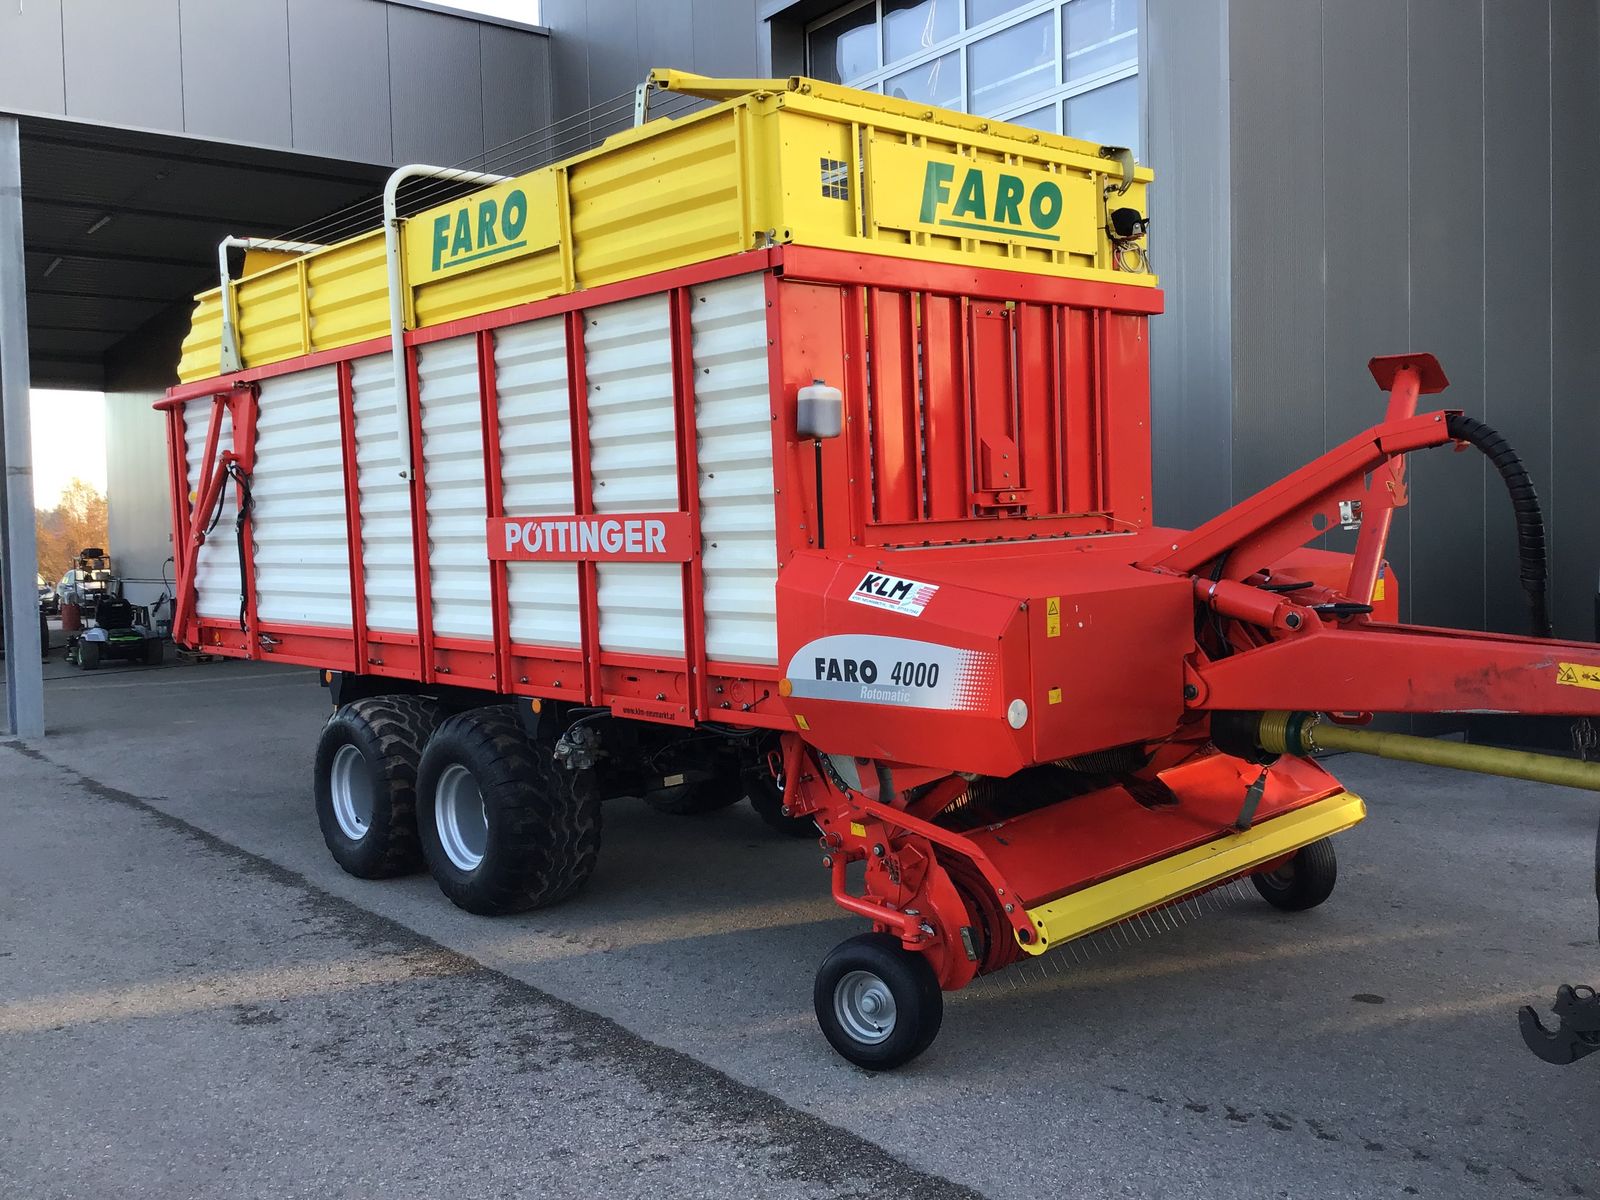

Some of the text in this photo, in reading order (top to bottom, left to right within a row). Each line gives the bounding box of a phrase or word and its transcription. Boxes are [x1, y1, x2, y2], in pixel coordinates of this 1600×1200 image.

[918, 160, 1063, 231] FARO
[431, 189, 528, 273] FARO
[504, 519, 667, 554] PÖTTINGER
[814, 657, 940, 688] FARO 4000
[860, 686, 911, 703] Rotomatic
